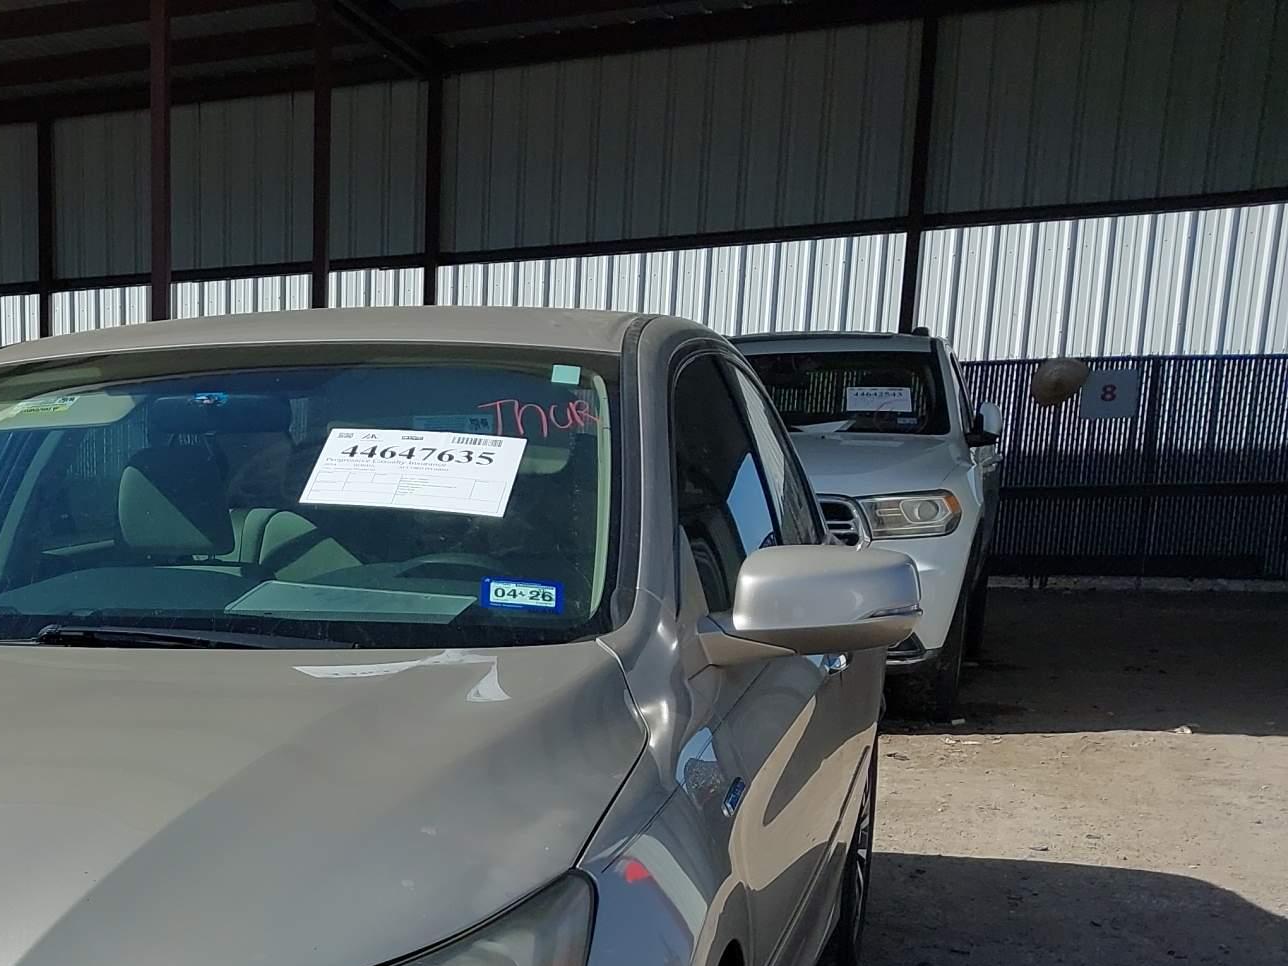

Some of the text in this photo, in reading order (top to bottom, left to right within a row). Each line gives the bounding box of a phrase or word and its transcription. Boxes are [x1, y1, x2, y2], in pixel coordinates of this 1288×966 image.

[1101, 384, 1117, 402] 8
[340, 444, 496, 466] 44647635
[494, 587, 553, 602] 04 26
